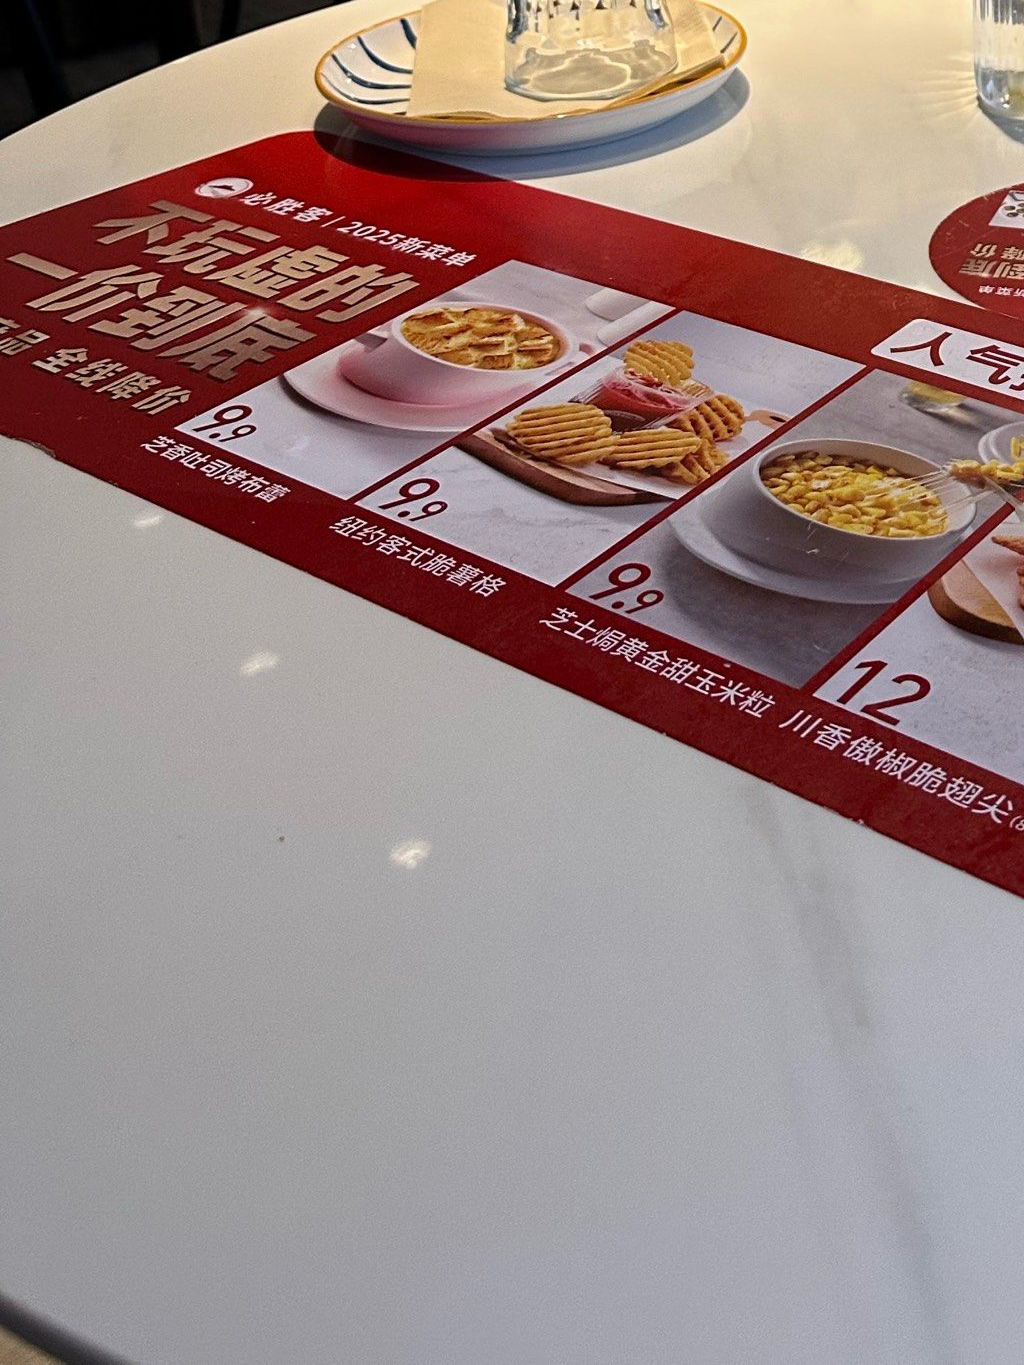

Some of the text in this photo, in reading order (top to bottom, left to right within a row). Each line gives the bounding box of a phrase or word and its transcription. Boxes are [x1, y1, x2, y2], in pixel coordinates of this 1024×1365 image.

[94, 199, 420, 324] 不玩虚的
[240, 192, 477, 267] 必胜客 2025新菜单
[6, 252, 317, 382] 一价到底
[32, 347, 192, 416] 全线降价
[193, 404, 257, 444] 9.9
[140, 435, 291, 504] 芝香吐司烤布蕾
[378, 477, 448, 522] 9.9
[329, 516, 506, 597] 纽约客式脆薯格
[588, 561, 664, 615] 9.9
[539, 606, 776, 718] 芝士焗黄金甜玉米粒
[836, 659, 932, 726] 12
